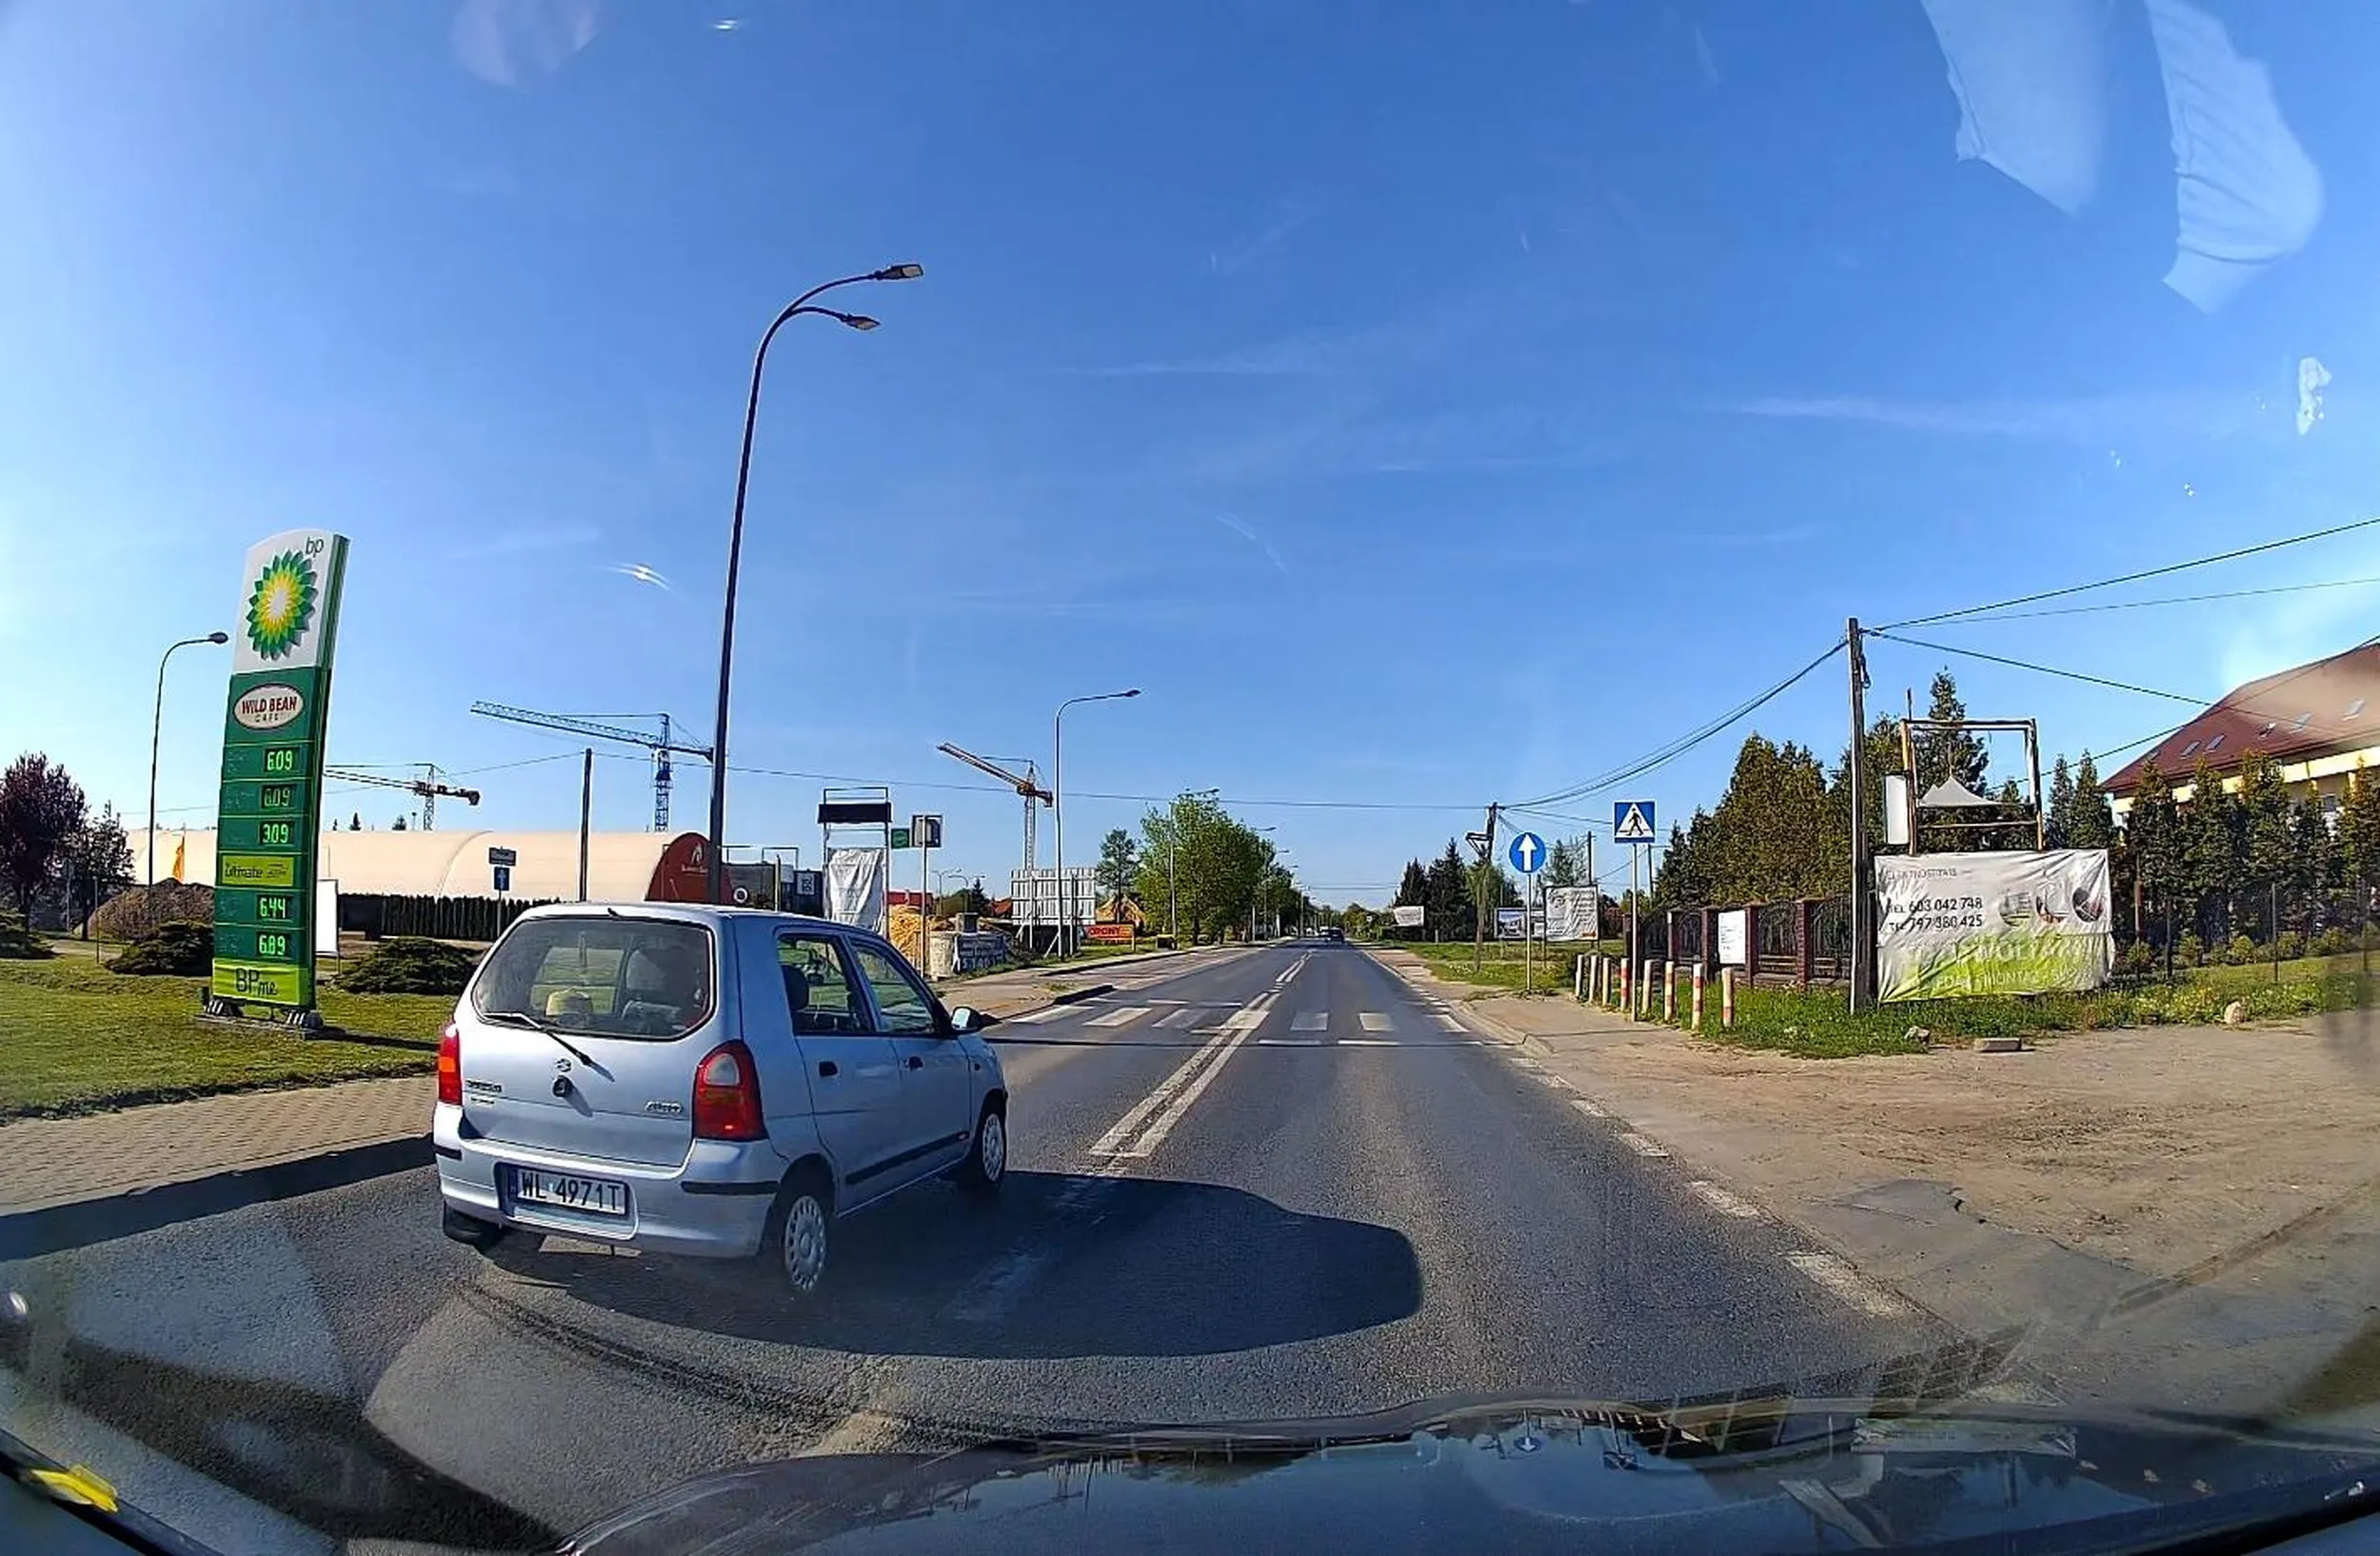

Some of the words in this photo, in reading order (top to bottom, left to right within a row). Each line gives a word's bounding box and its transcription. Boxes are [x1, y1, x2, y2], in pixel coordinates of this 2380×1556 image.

[305, 537, 325, 558] bp
[242, 698, 268, 714] WILD
[268, 696, 297, 713] BEAN
[1934, 898, 1957, 911] 042
[1959, 896, 1983, 909] 748
[1959, 914, 1983, 928] 425
[520, 1170, 547, 1200] WL
[556, 1177, 620, 1211] 4971T
